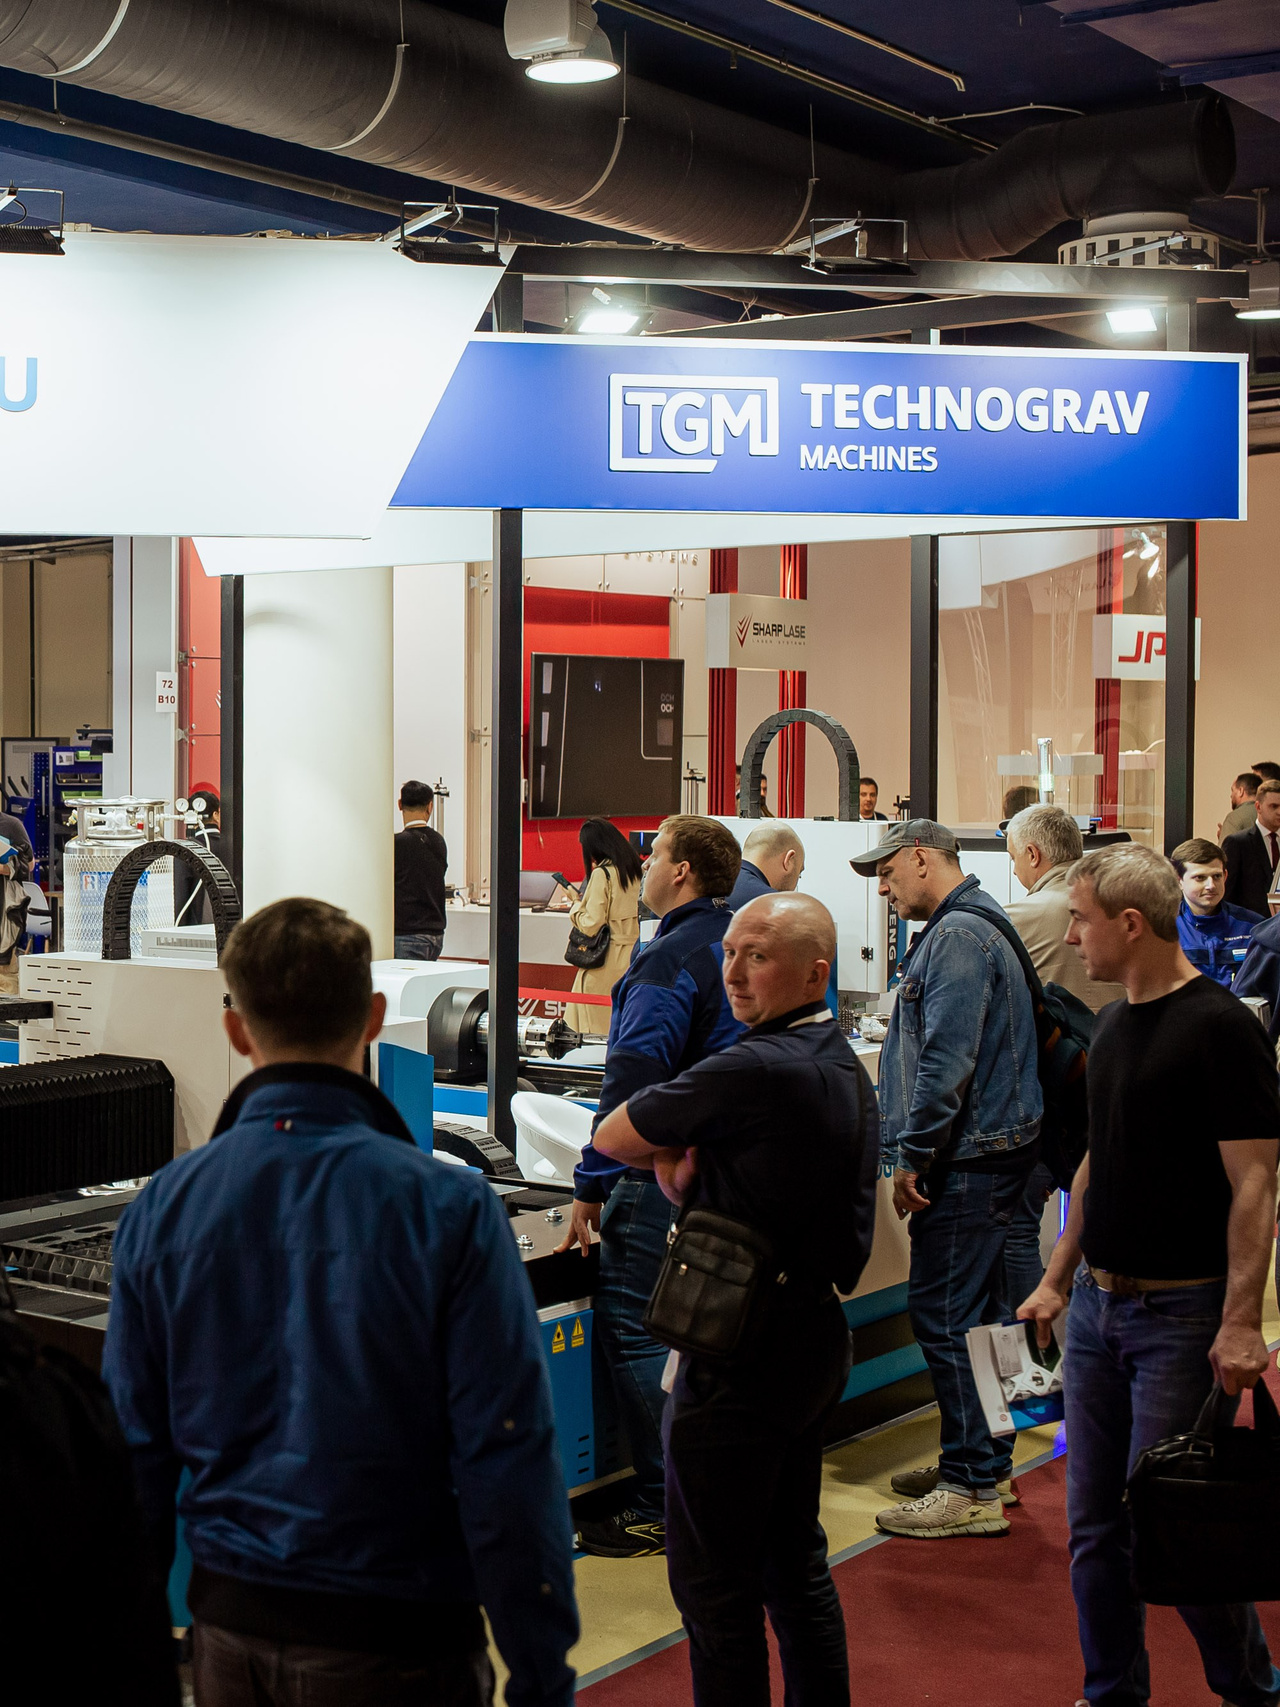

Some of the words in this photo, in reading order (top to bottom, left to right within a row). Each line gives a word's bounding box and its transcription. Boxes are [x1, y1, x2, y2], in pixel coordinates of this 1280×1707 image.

[622, 388, 778, 457] TGM
[800, 382, 1151, 435] TECHNOGRAV
[799, 444, 939, 472] MACHINES
[162, 679, 173, 689] 72
